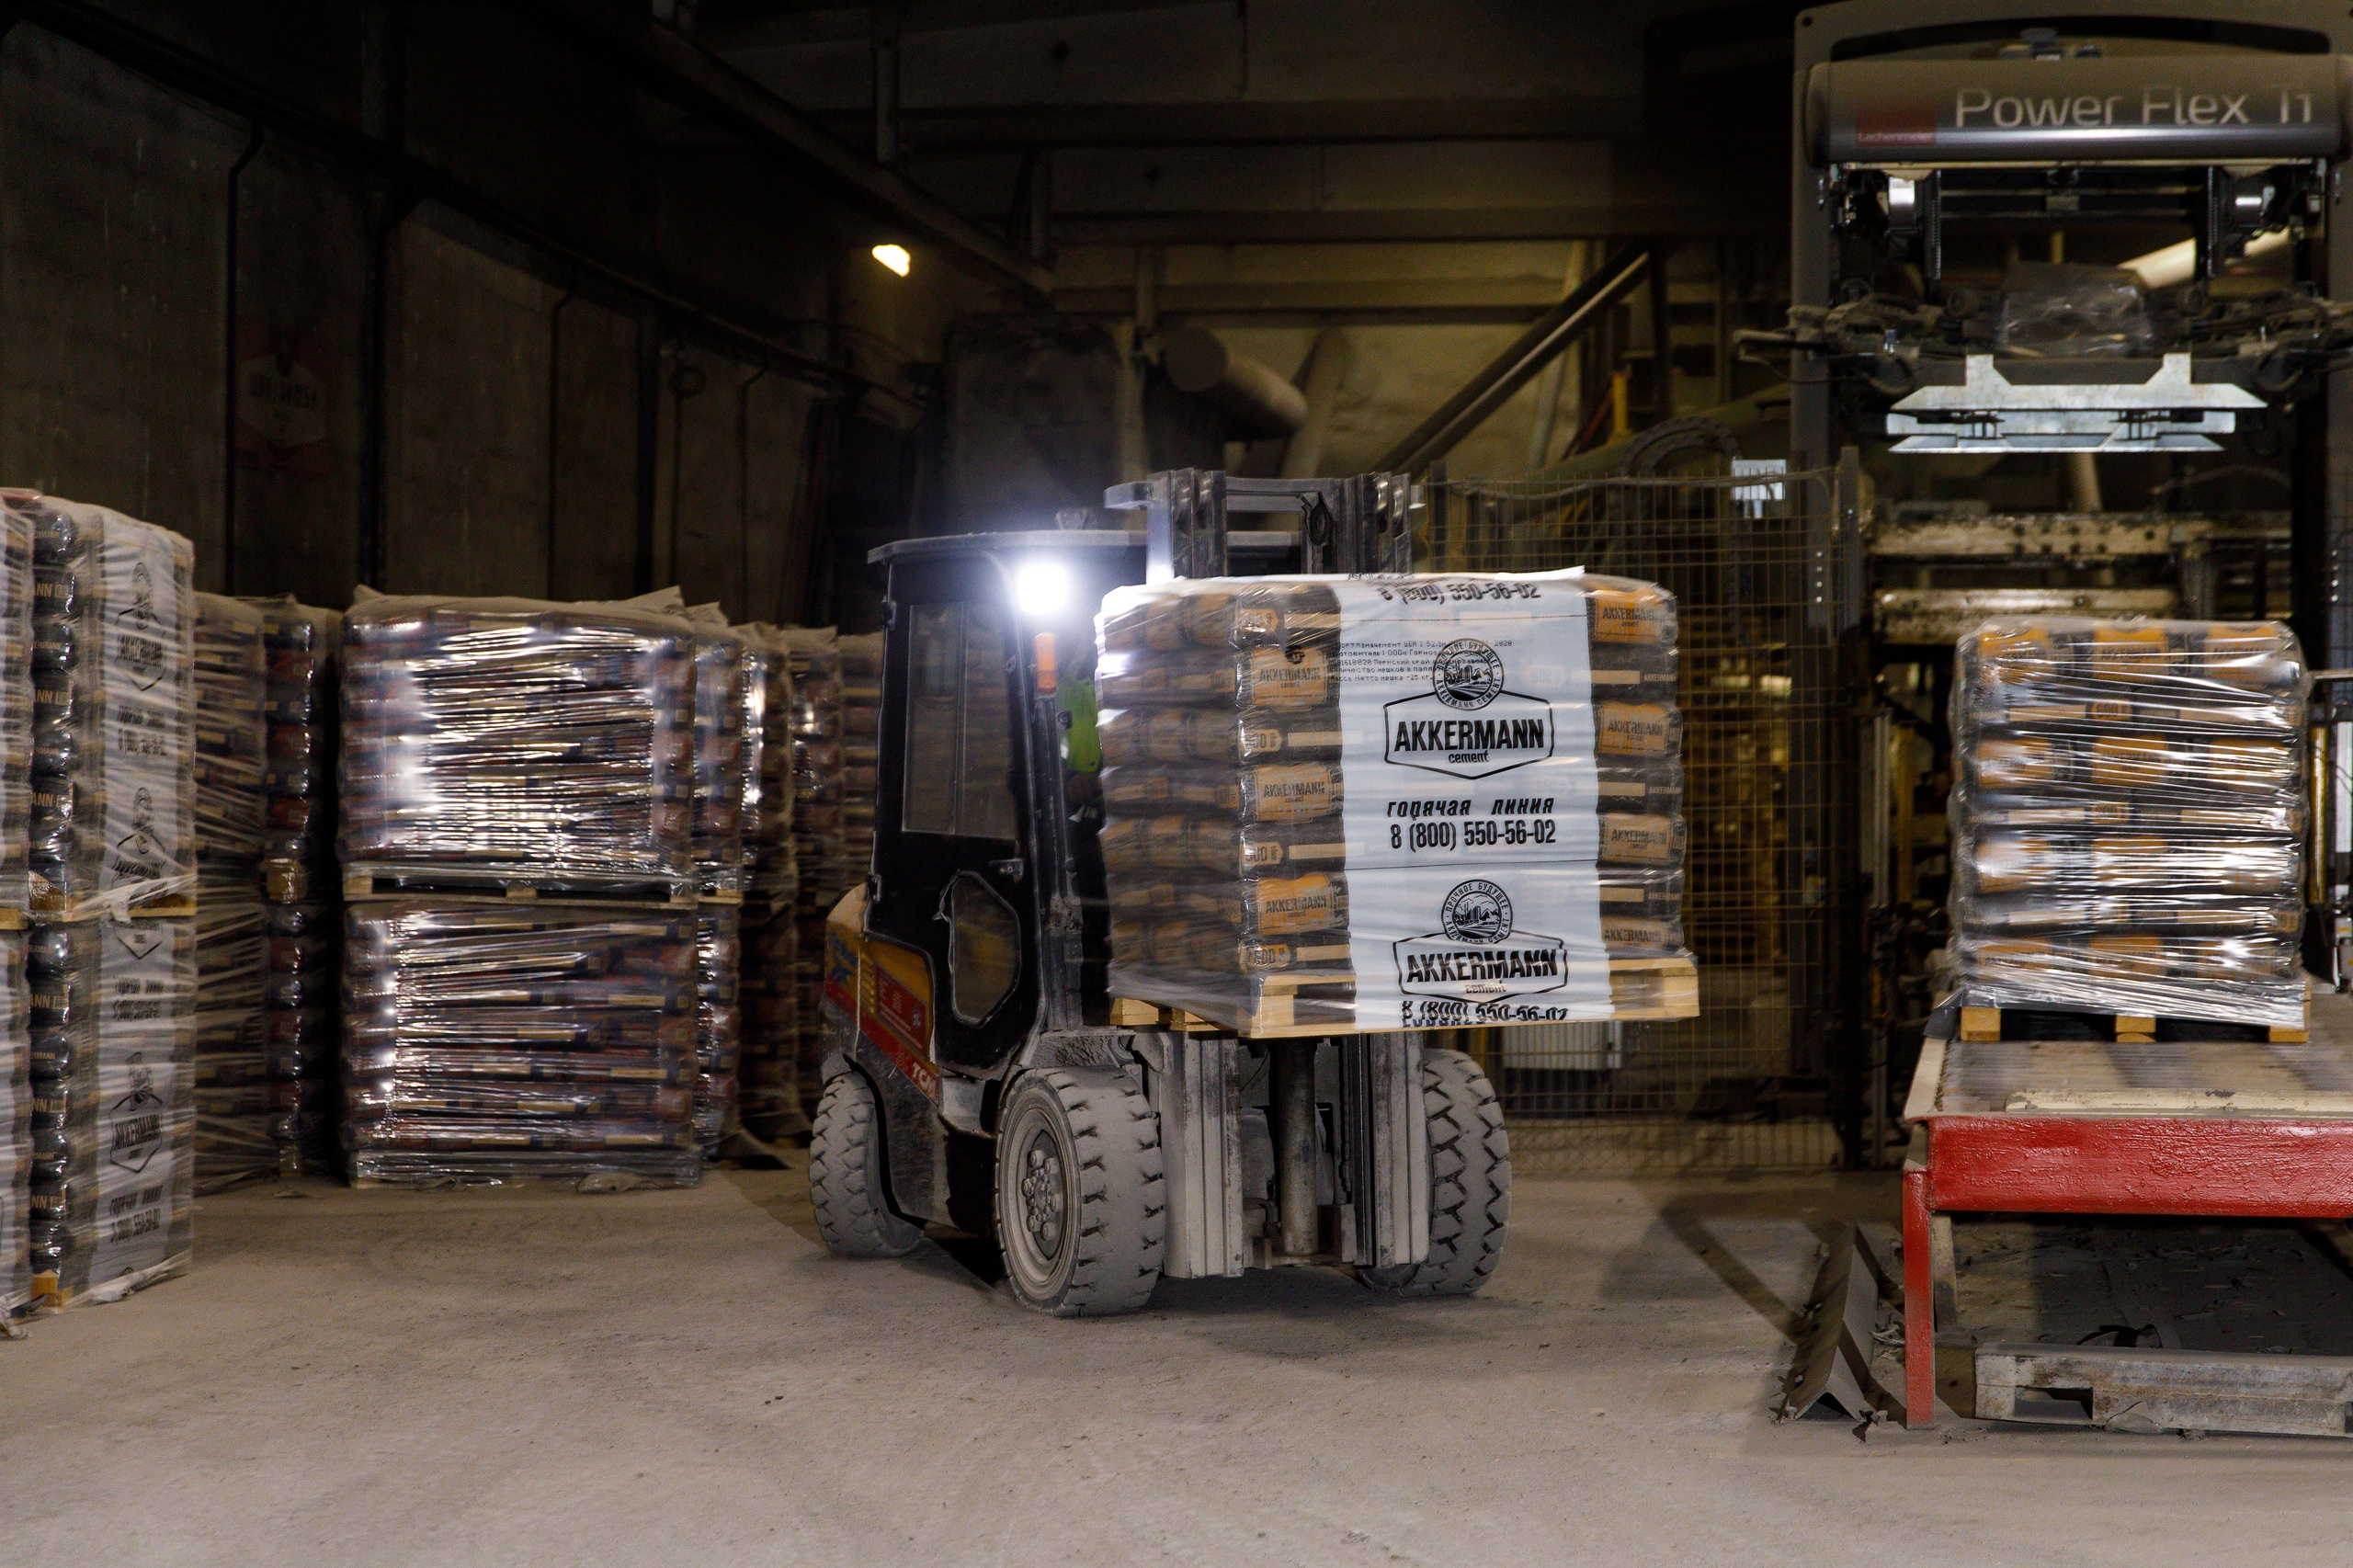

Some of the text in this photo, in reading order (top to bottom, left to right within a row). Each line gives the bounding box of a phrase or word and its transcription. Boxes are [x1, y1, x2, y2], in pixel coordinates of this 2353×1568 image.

[1955, 87, 2122, 128] Power
[2142, 85, 2250, 126] Flex
[1446, 582, 1541, 601] 550-56-02
[1436, 677, 1501, 709] AKKERMANN CEMENT
[1394, 719, 1545, 752] AKKERMANN
[1448, 750, 1490, 763] cement
[1387, 797, 1555, 821] горячая линия
[1390, 819, 1556, 853] 8 (800) 550-56-02
[1265, 894, 1327, 914] AKKERMANN
[1446, 881, 1509, 913] ПРОЧНОЕ БУДУЩЕЕ
[1406, 949, 1558, 983] AKKERMANN
